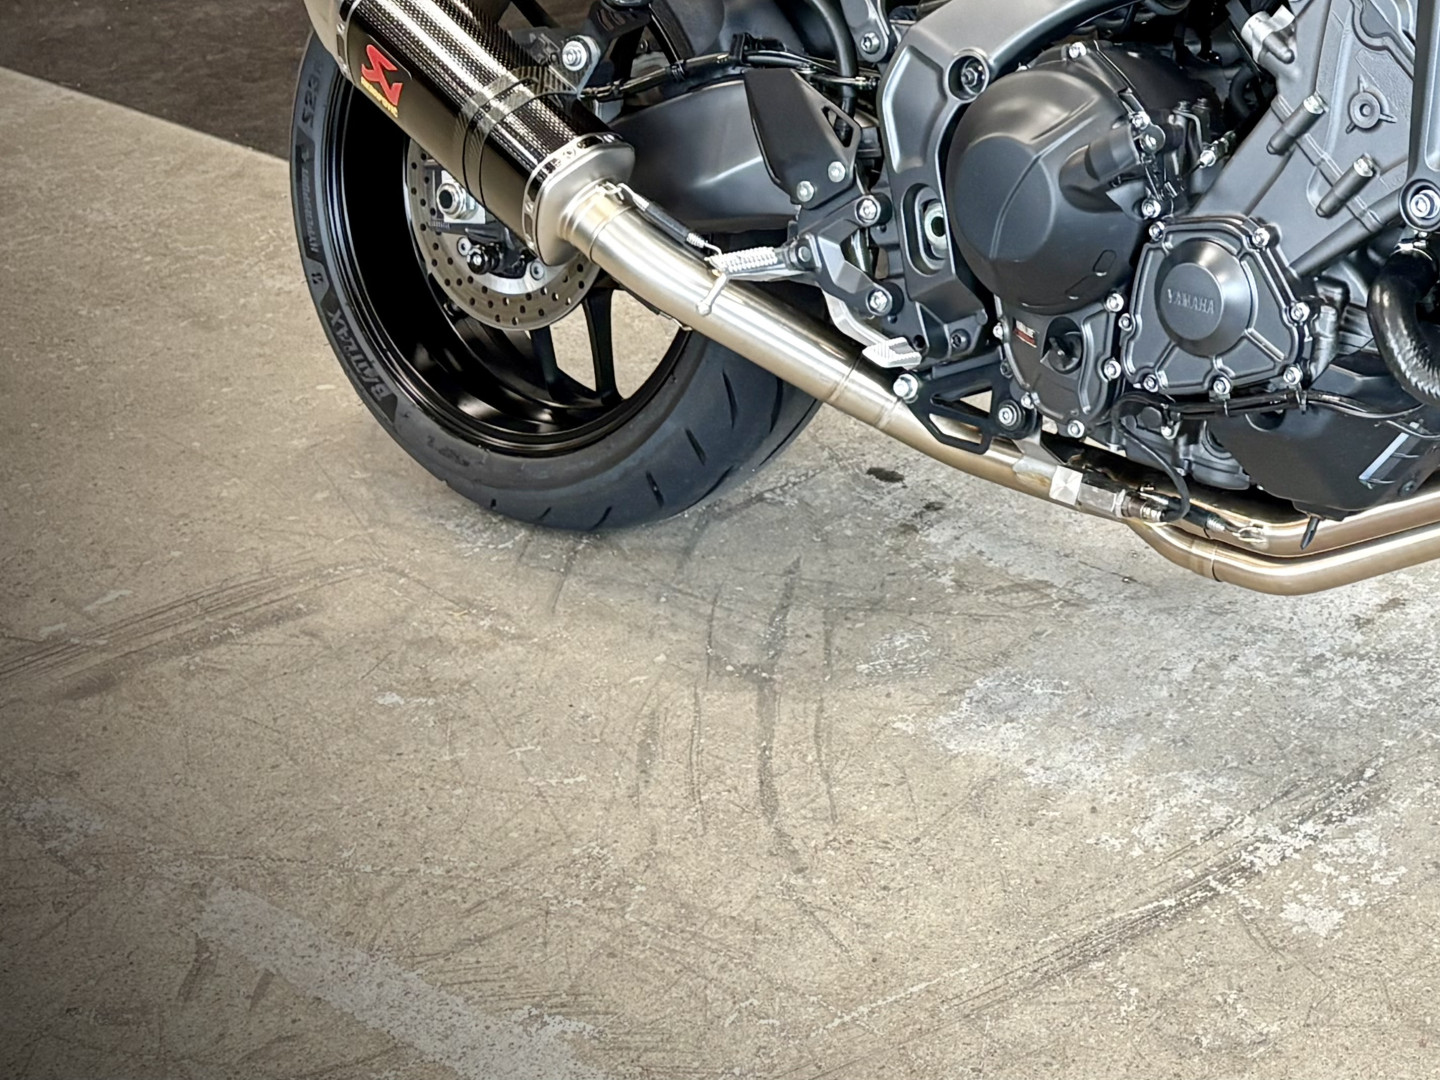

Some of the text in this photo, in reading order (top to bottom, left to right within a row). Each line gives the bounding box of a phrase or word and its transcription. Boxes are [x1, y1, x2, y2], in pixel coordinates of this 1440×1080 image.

[302, 170, 320, 254] HYPERSPORT
[1167, 288, 1215, 315] YAMAHA
[327, 308, 391, 402] BATTLAX
